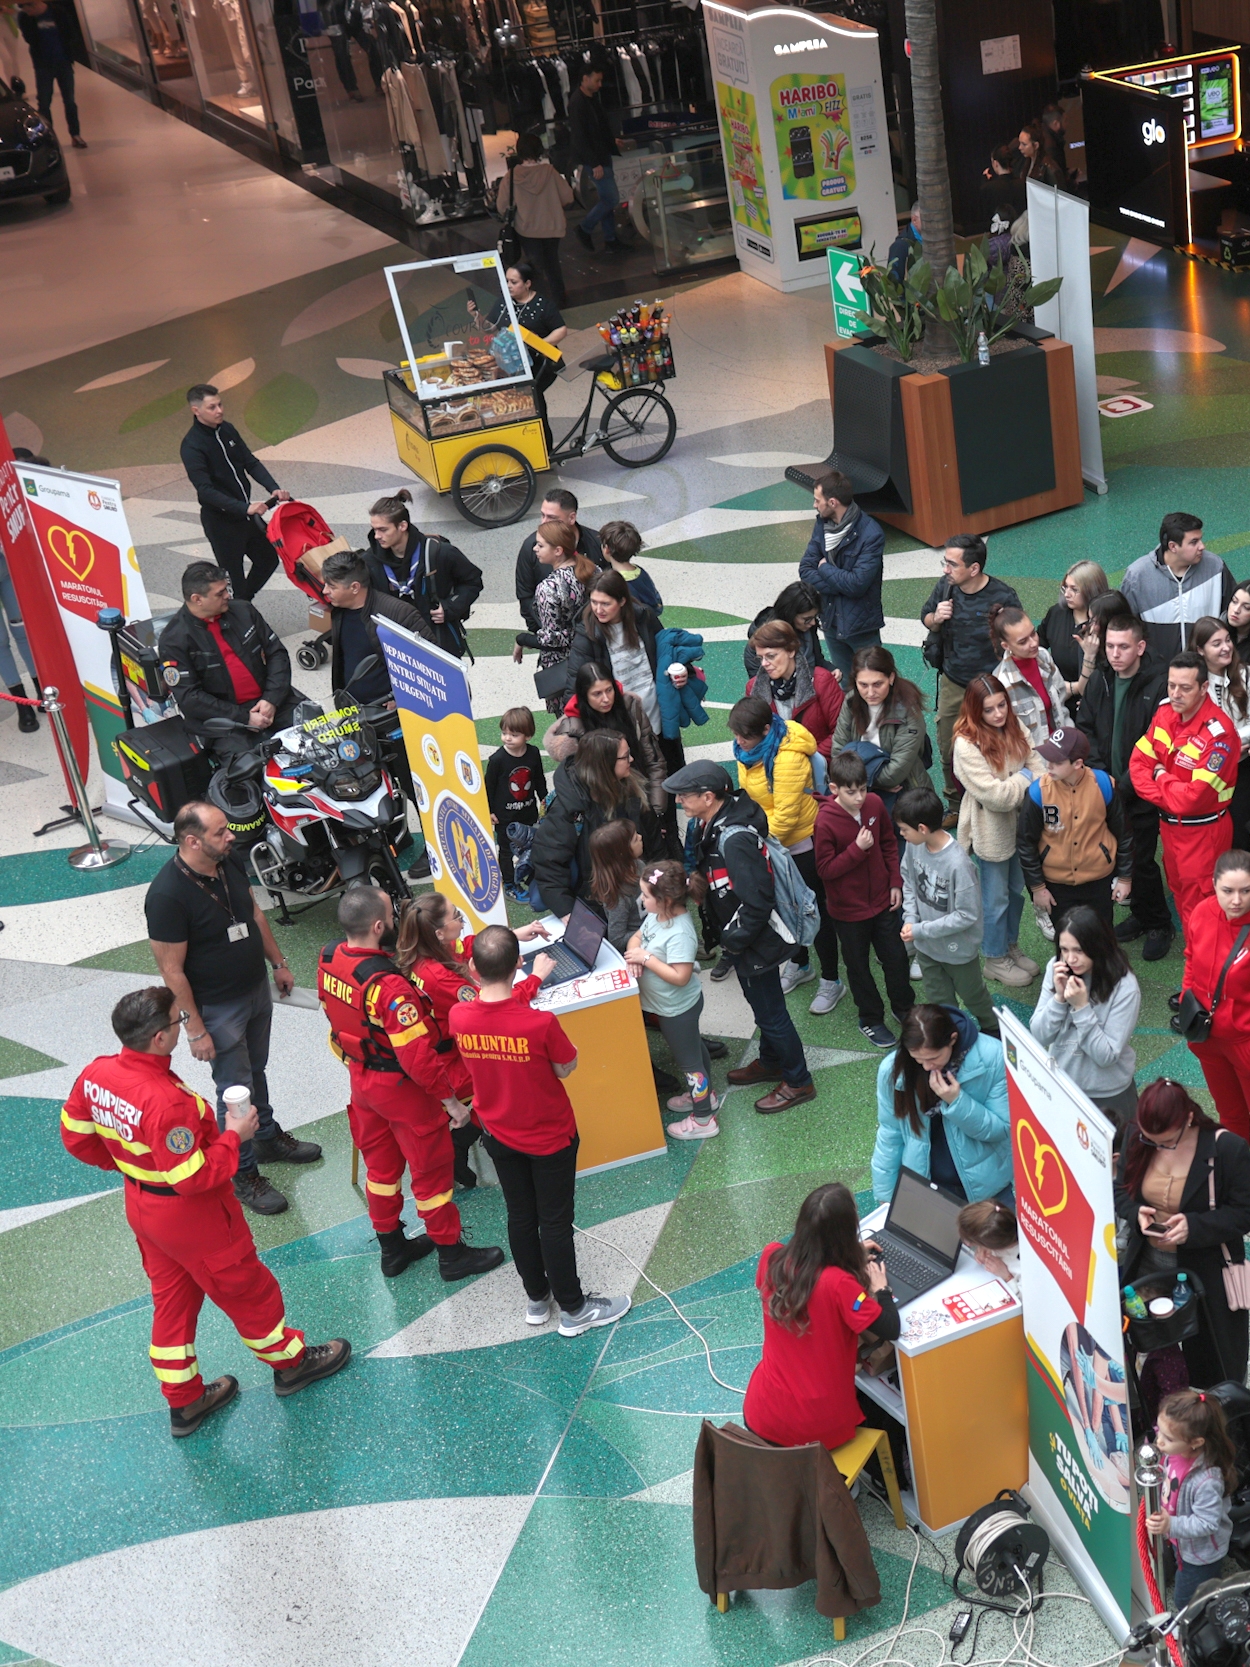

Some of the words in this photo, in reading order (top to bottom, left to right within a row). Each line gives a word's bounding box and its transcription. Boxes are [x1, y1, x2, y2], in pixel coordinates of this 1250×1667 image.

[717, 52, 745, 75] GRATUIT
[779, 82, 838, 106] HARIBO
[852, 93, 872, 101] GRATIS
[730, 119, 750, 135] HARIBO
[1142, 118, 1166, 146] glo
[821, 186, 847, 196] GRATUIT
[822, 177, 845, 187] PRODUS
[848, 320, 857, 329] DE
[468, 334, 481, 345] to
[38, 484, 71, 499] Groupama
[60, 580, 104, 598] MARATONUL
[383, 641, 447, 687] DEPARTAMENTUL
[387, 657, 416, 682] PENTRU
[416, 674, 448, 702] SITUAȚII
[390, 673, 399, 688] DE
[226, 811, 266, 832] PARAMEDI
[1042, 804, 1060, 825] B
[485, 848, 495, 862] DE
[323, 972, 353, 1005] MEDIC
[456, 1032, 530, 1054] VOLUNTAR
[481, 1052, 502, 1060] pentru
[1020, 1059, 1052, 1101] Groupama
[1020, 1197, 1070, 1260] MARATONUL
[1020, 1215, 1073, 1280] RESUSCITĂRII
[1055, 1432, 1071, 1467] TU
[1072, 1458, 1099, 1514] POȚI
[1056, 1454, 1092, 1521] SALVA
[1060, 1477, 1068, 1491] O
